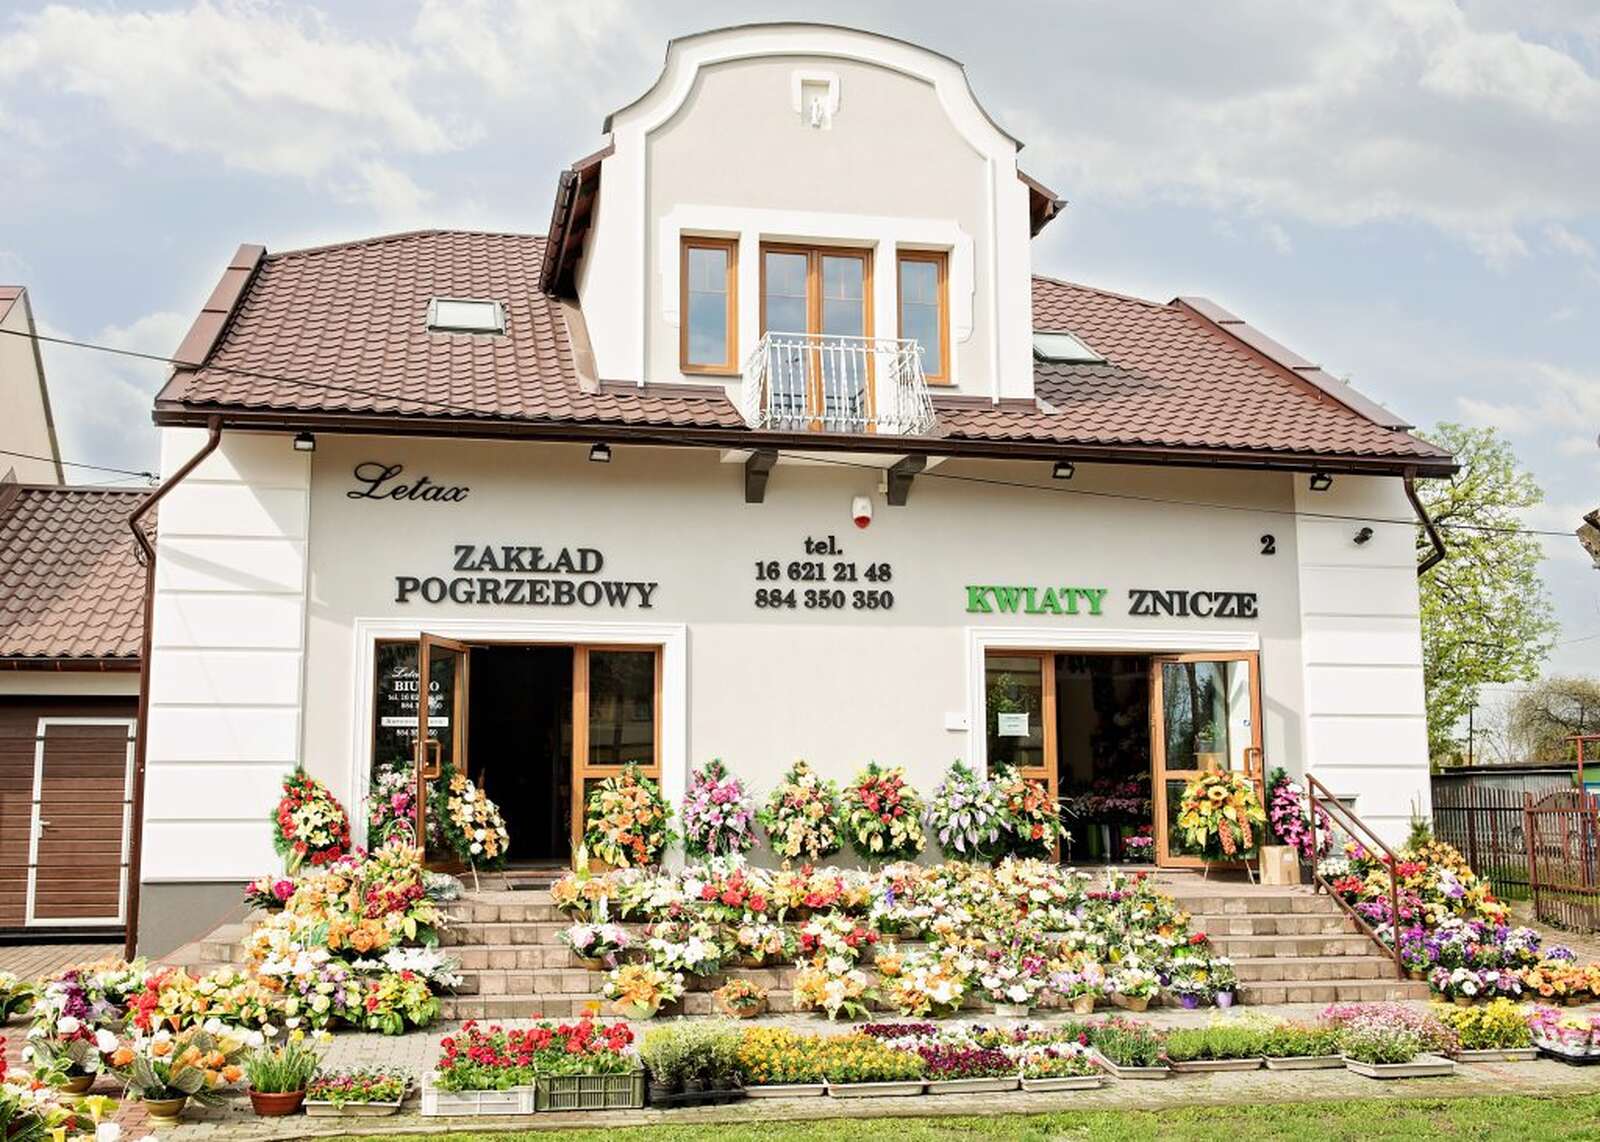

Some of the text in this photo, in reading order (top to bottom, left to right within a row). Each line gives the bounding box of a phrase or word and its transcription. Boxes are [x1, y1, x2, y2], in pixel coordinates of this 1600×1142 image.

[346, 462, 470, 502] Letax
[804, 535, 843, 555] tel.
[1260, 534, 1276, 555] 2
[453, 545, 604, 574] ZAKŁAD
[755, 561, 892, 582] 16 621 21 48
[394, 576, 658, 608] POGRZEBOWY
[754, 588, 894, 610] 884 350 350
[965, 585, 1259, 619] KWIATY ZNICZE
[391, 666, 420, 678] Leta
[394, 681, 440, 692] BIUO
